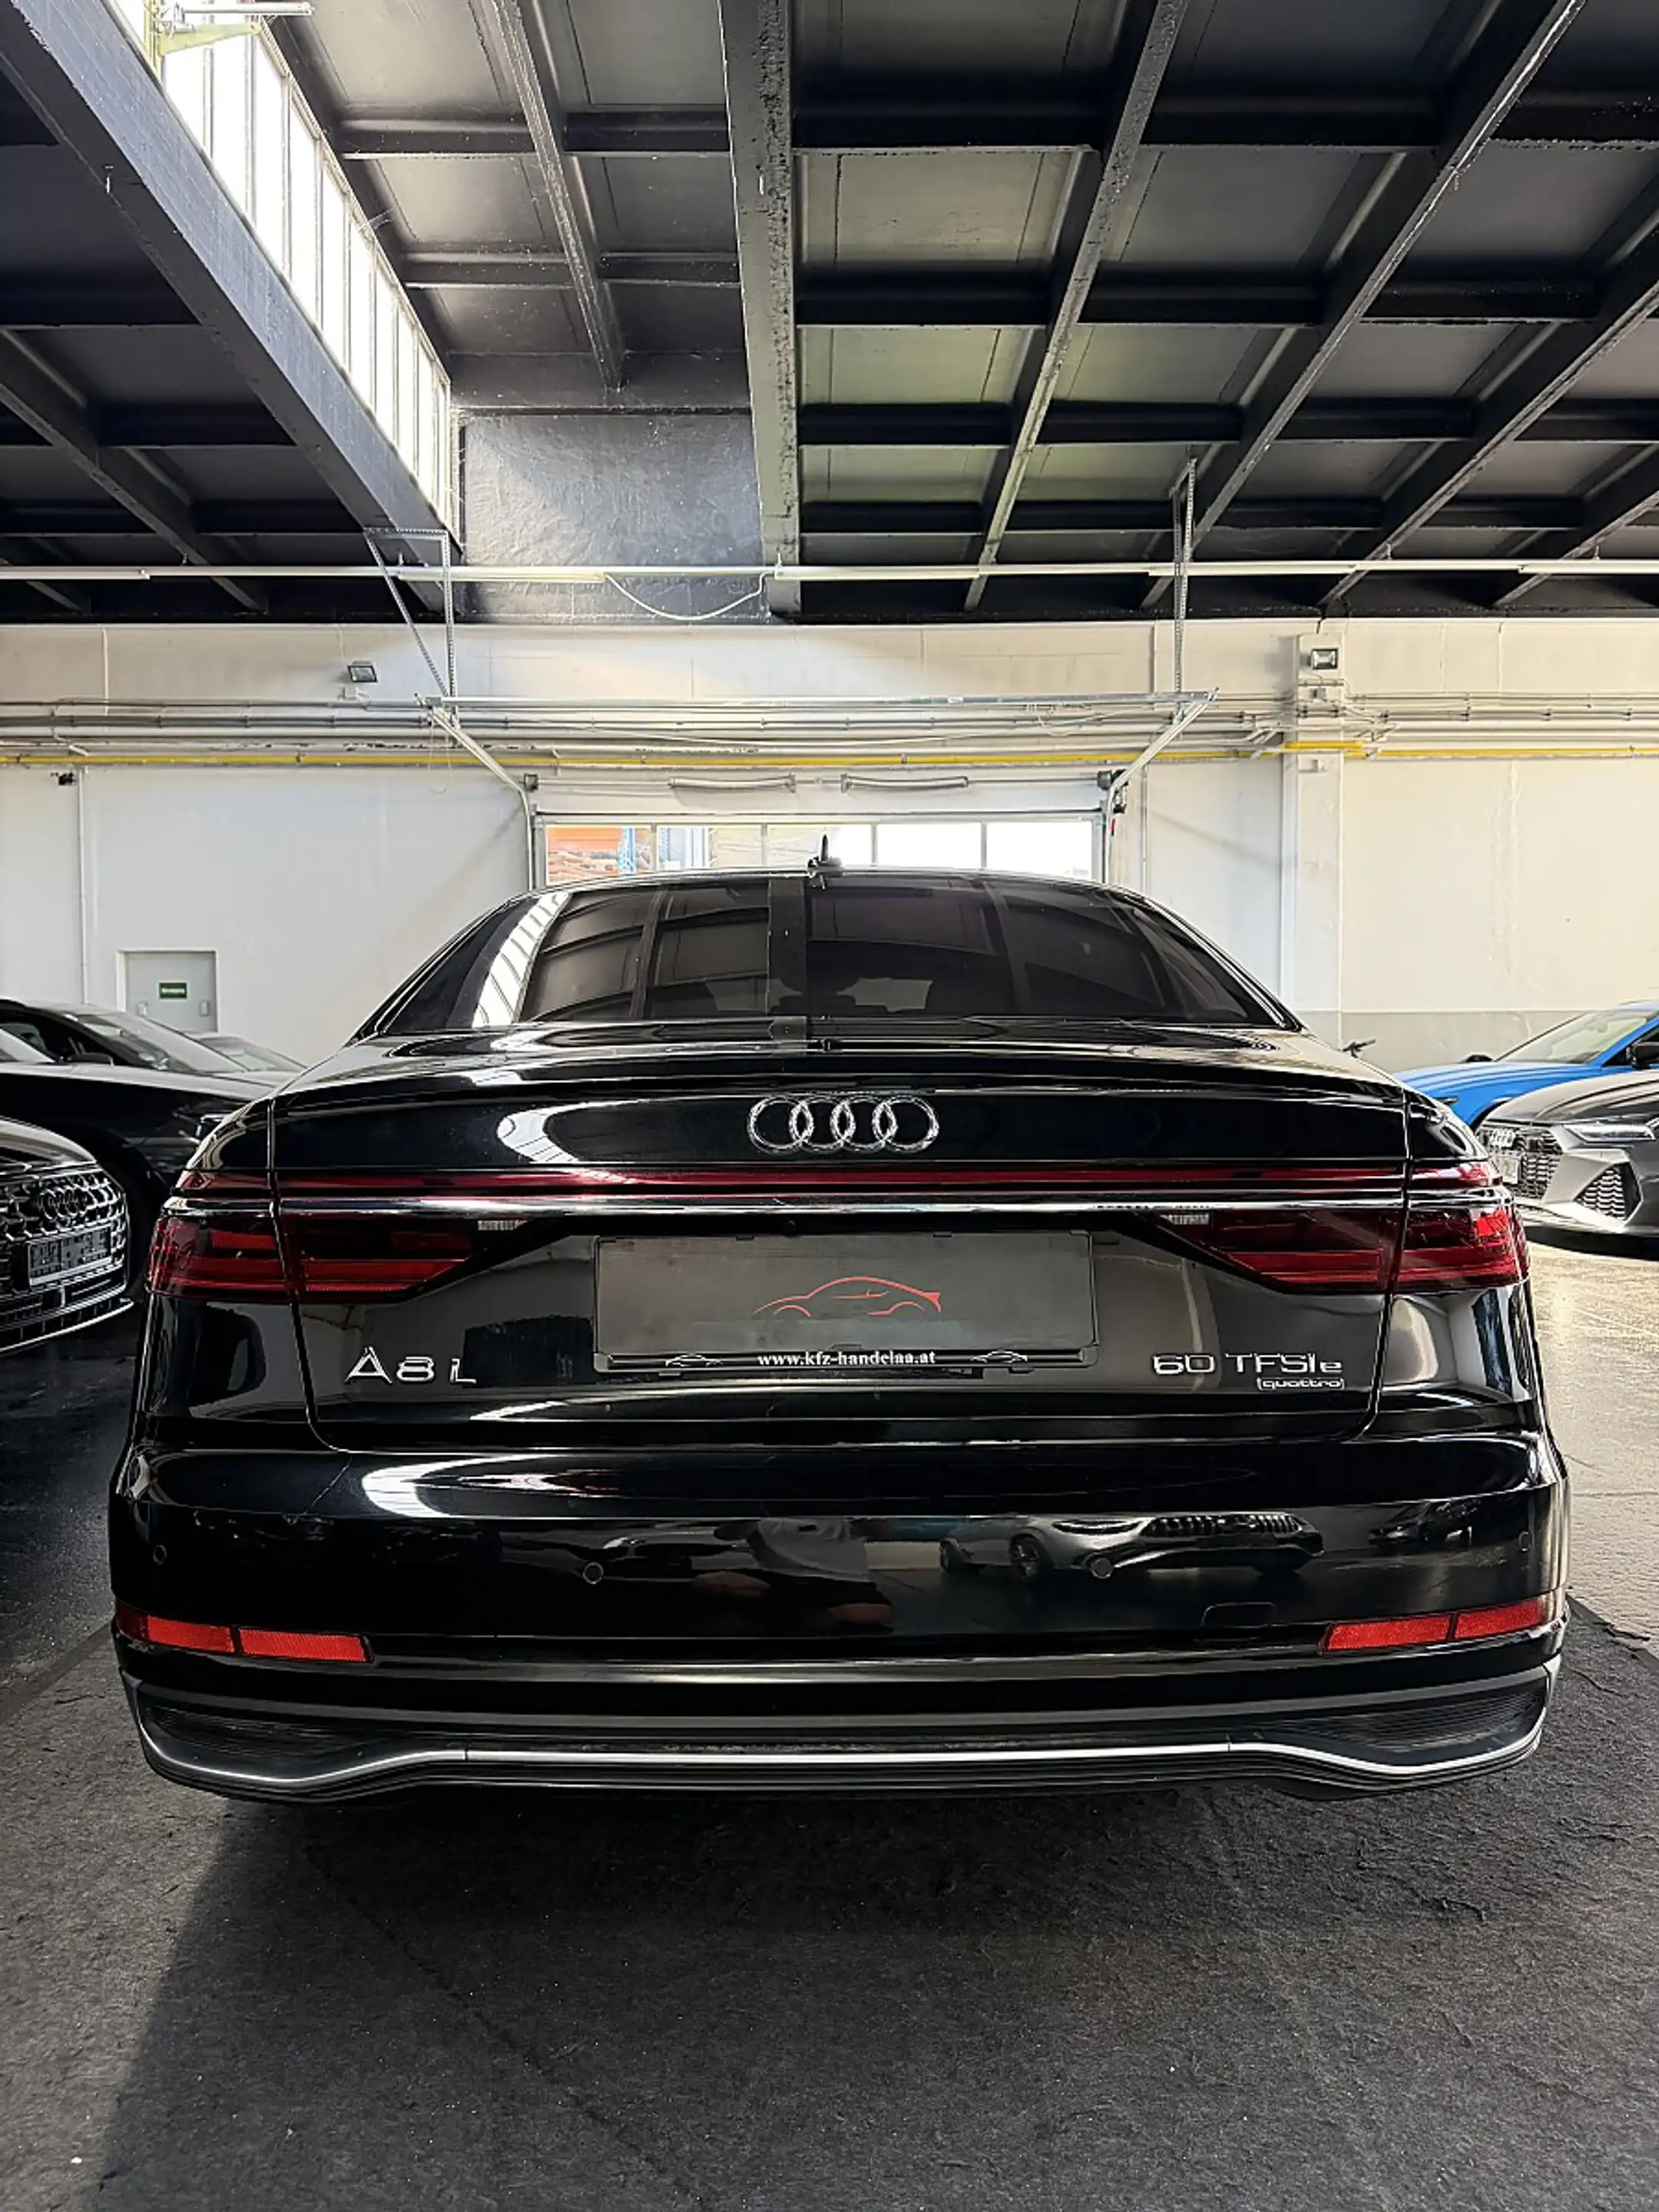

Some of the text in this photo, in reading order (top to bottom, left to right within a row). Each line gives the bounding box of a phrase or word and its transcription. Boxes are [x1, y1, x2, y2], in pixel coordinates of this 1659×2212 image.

[345, 1346, 477, 1383] A8 L
[1152, 1353, 1216, 1375] 60
[1260, 1378, 1343, 1389] quattro
